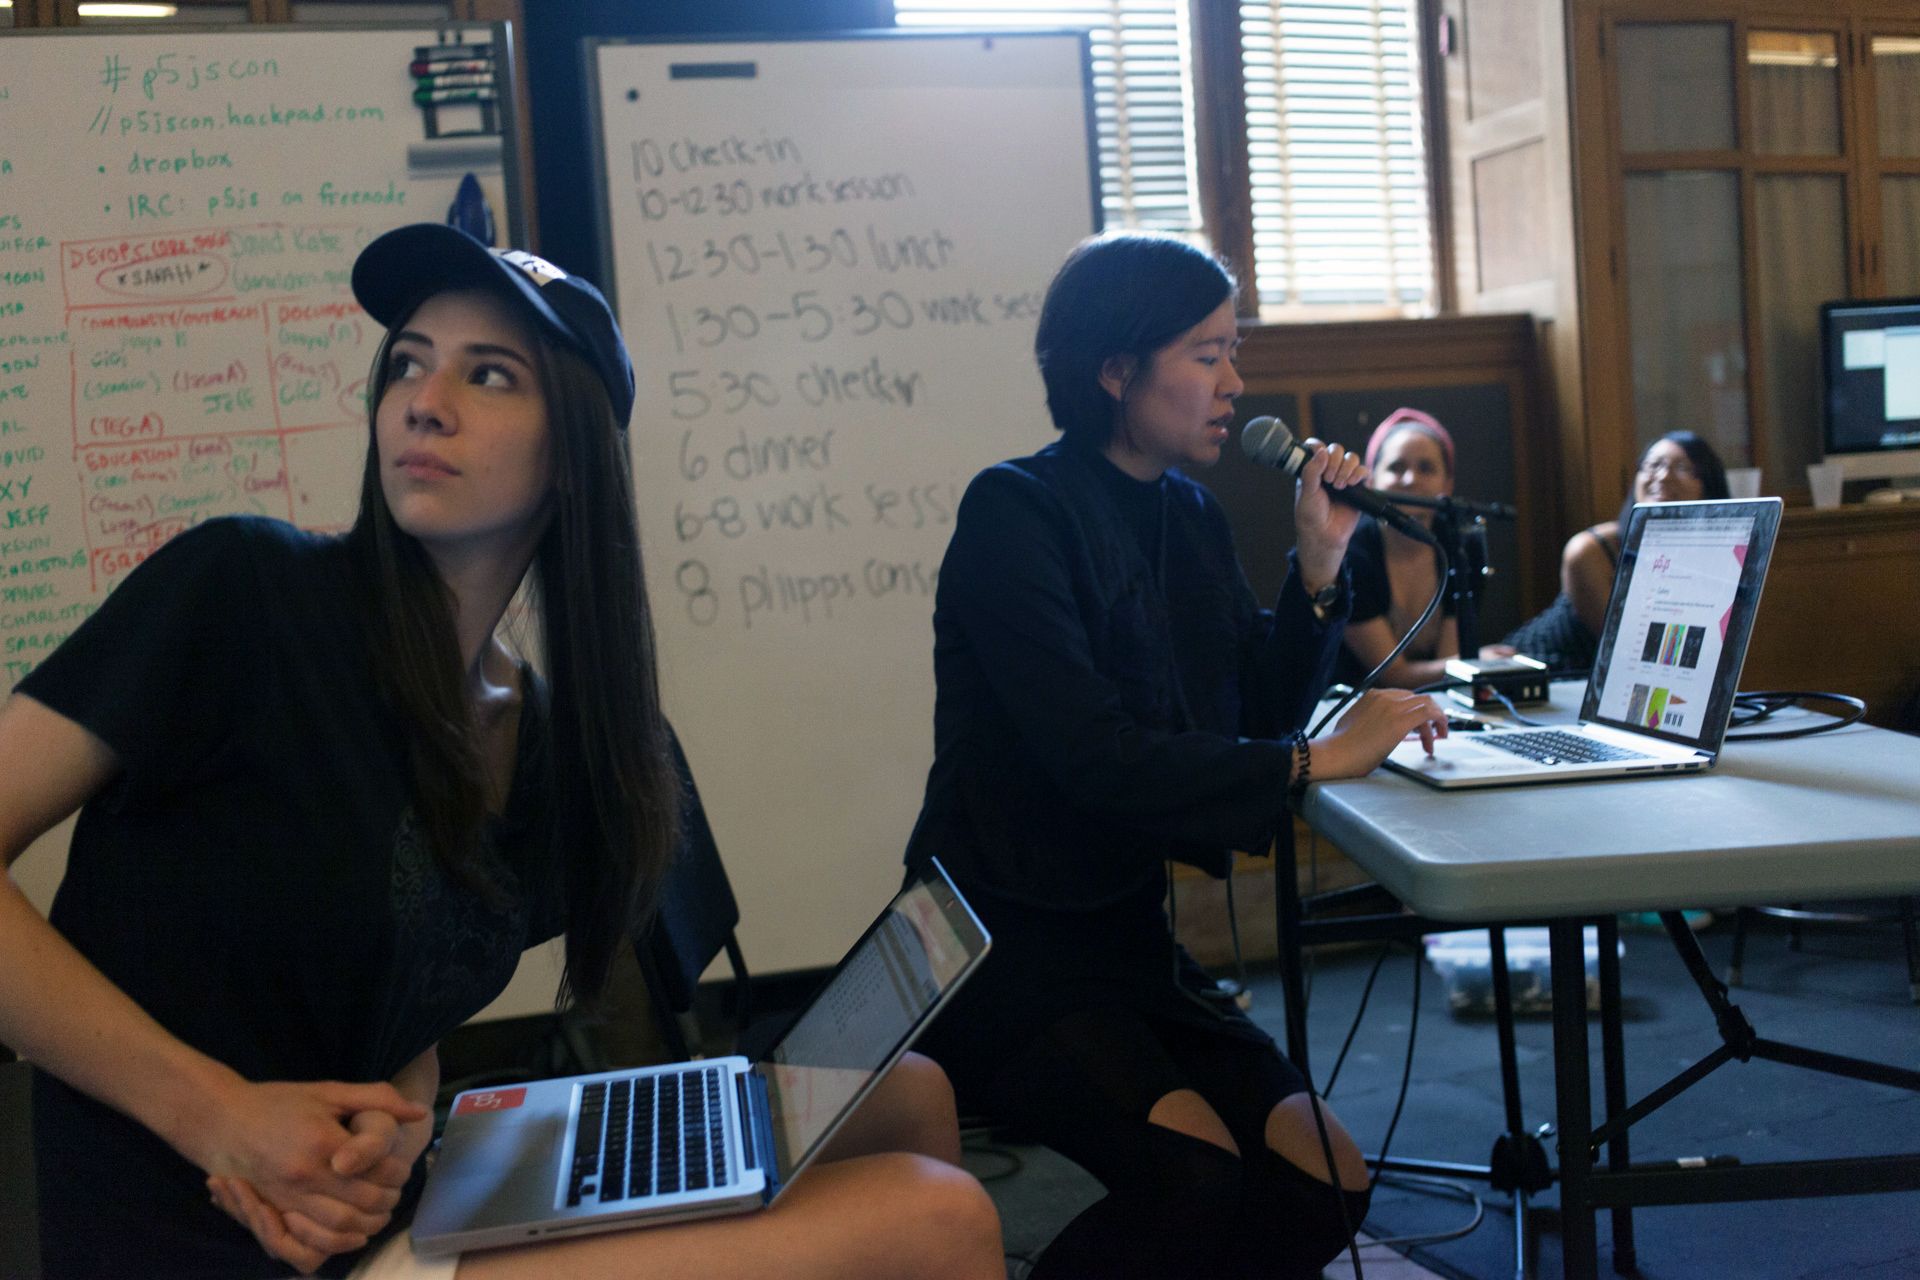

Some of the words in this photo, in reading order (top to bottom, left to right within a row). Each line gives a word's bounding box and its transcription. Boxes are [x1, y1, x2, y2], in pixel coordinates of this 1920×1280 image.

[127, 148, 234, 175] dropbox
[630, 138, 665, 183] 10
[207, 186, 260, 217] p5js
[281, 190, 304, 206] on
[317, 181, 406, 207] freenode
[866, 224, 955, 274] lunch
[678, 429, 709, 482] 6
[723, 428, 835, 481] dinner
[2, 504, 51, 531] JEFF
[756, 483, 850, 531] work
[674, 558, 719, 627] 8
